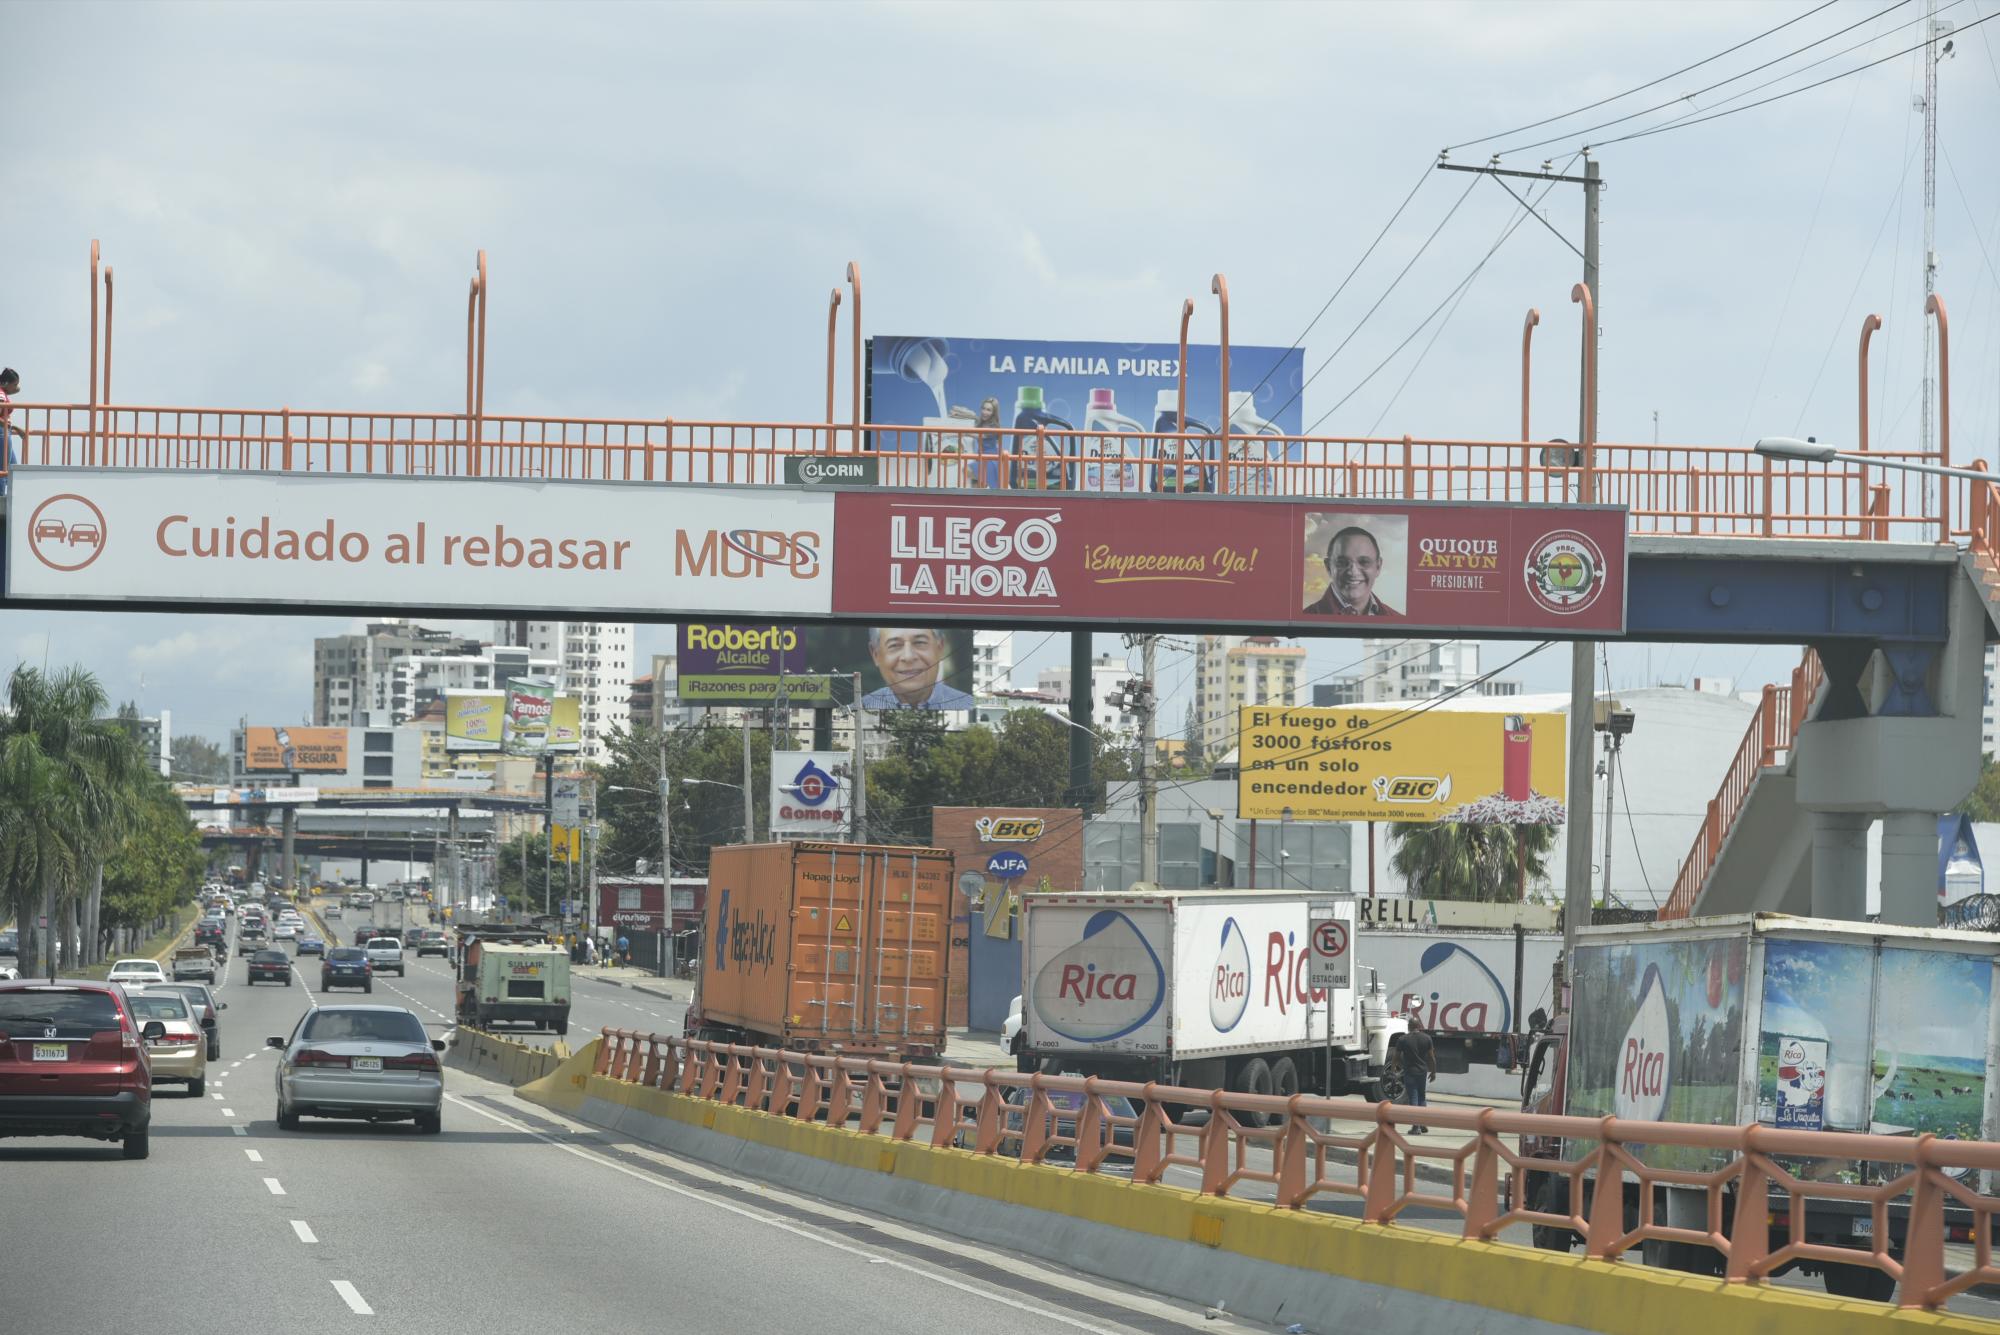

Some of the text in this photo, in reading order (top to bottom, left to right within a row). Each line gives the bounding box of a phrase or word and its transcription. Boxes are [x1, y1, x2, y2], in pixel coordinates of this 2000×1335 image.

[989, 355, 1188, 377] LA FAMILIA PUREX
[156, 514, 631, 571] Cuidado al rebasar
[890, 512, 1062, 562] LLEGÓ
[1420, 538, 1498, 556] QUIQUE
[1213, 546, 1258, 577] Ya!
[890, 563, 1058, 598] LA HORA
[1431, 575, 1484, 589] PRESIDENTE
[687, 624, 797, 650] Roberto
[716, 650, 770, 664] Alcalde
[749, 682, 777, 695] para
[1253, 712, 1369, 731] El fuego de
[1252, 735, 1392, 751] 3000 fósforos
[297, 753, 338, 763] SEGURA
[1252, 758, 1359, 772] en un solo
[1251, 781, 1368, 795] encendedor
[1367, 810, 1387, 818] hasta
[1388, 810, 1405, 818] 3000
[989, 859, 1027, 870] AJFA
[507, 960, 545, 968] SULLAIR
[1324, 963, 1335, 971] NO
[1059, 963, 1137, 1006] Rica
[1215, 964, 1245, 1002] Rica
[1784, 1050, 1802, 1060] Rica
[1622, 1038, 1665, 1104] Rica
